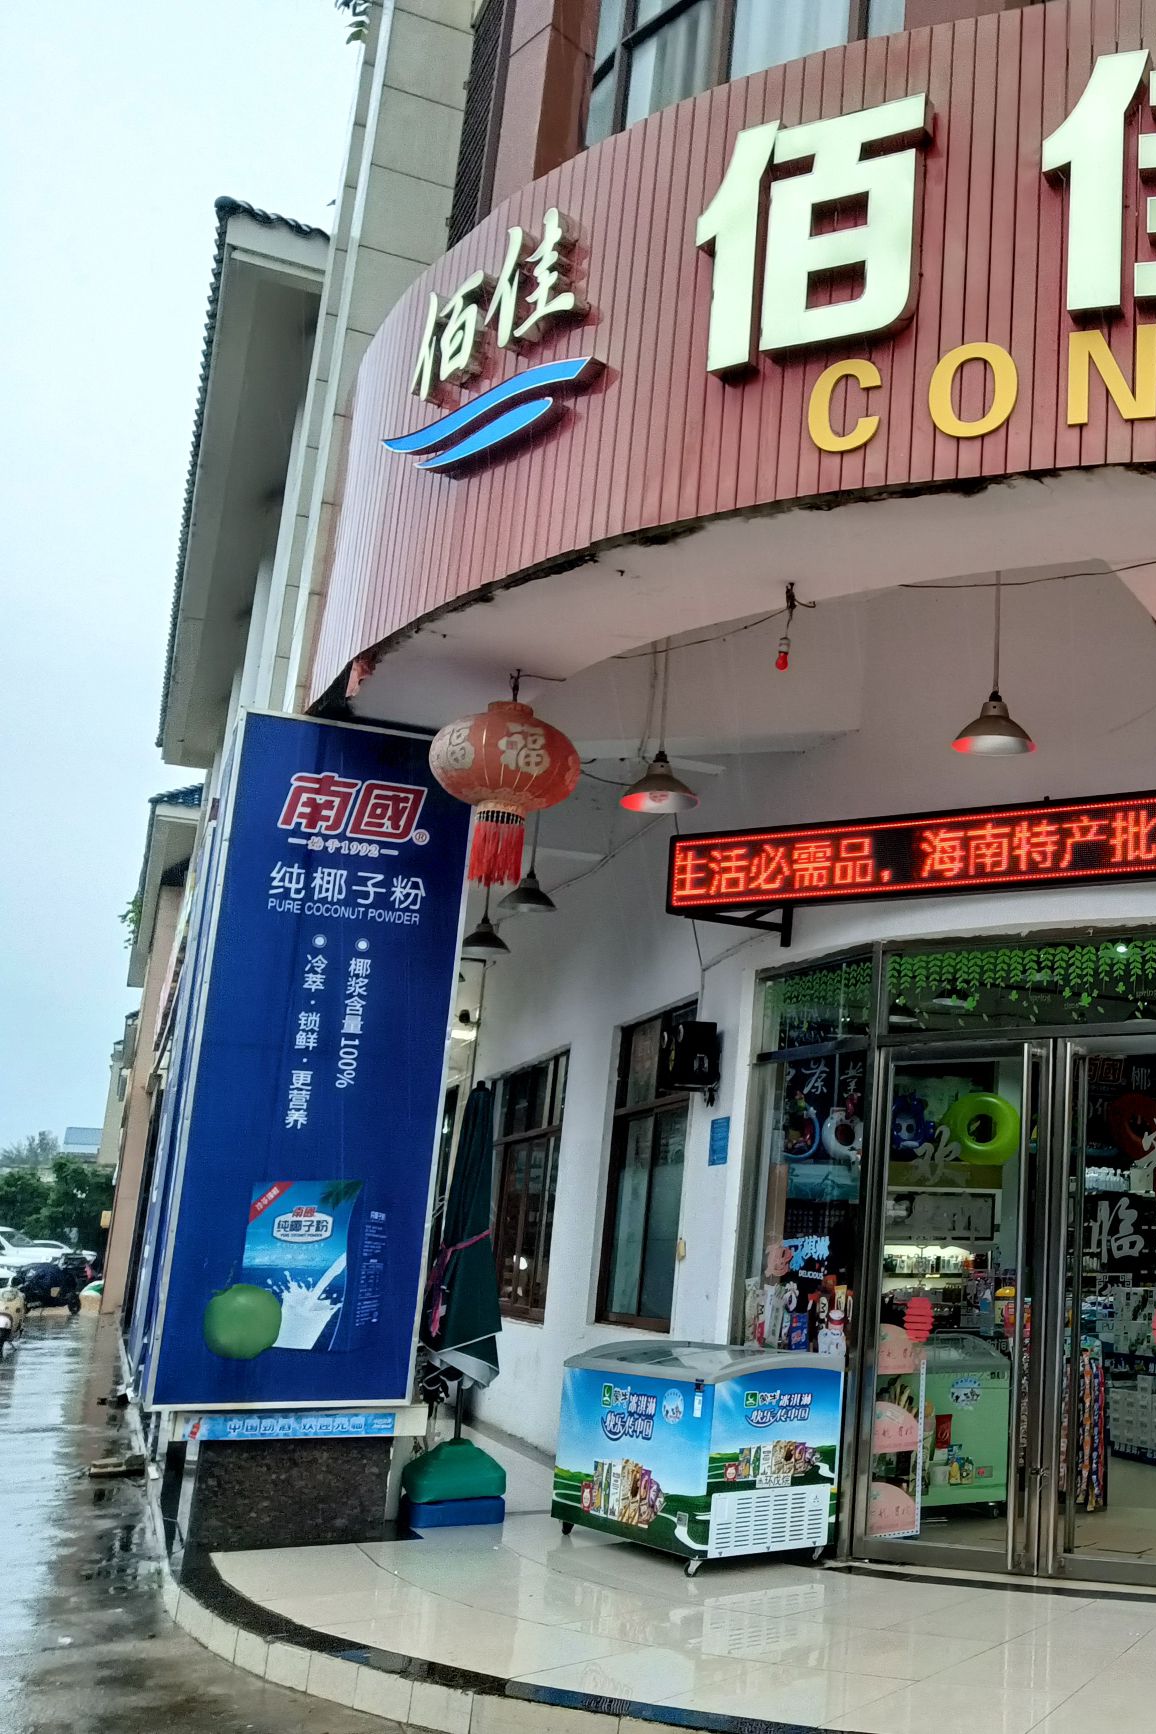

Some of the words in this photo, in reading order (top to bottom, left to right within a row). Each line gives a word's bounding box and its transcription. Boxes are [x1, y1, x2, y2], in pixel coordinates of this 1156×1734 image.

[411, 207, 578, 402] 佰佳
[277, 772, 427, 843] 南國
[268, 861, 426, 910] 纯椰子粉
[268, 898, 301, 913] PURE
[305, 902, 365, 920] COCONUT
[368, 910, 420, 925] POWDER
